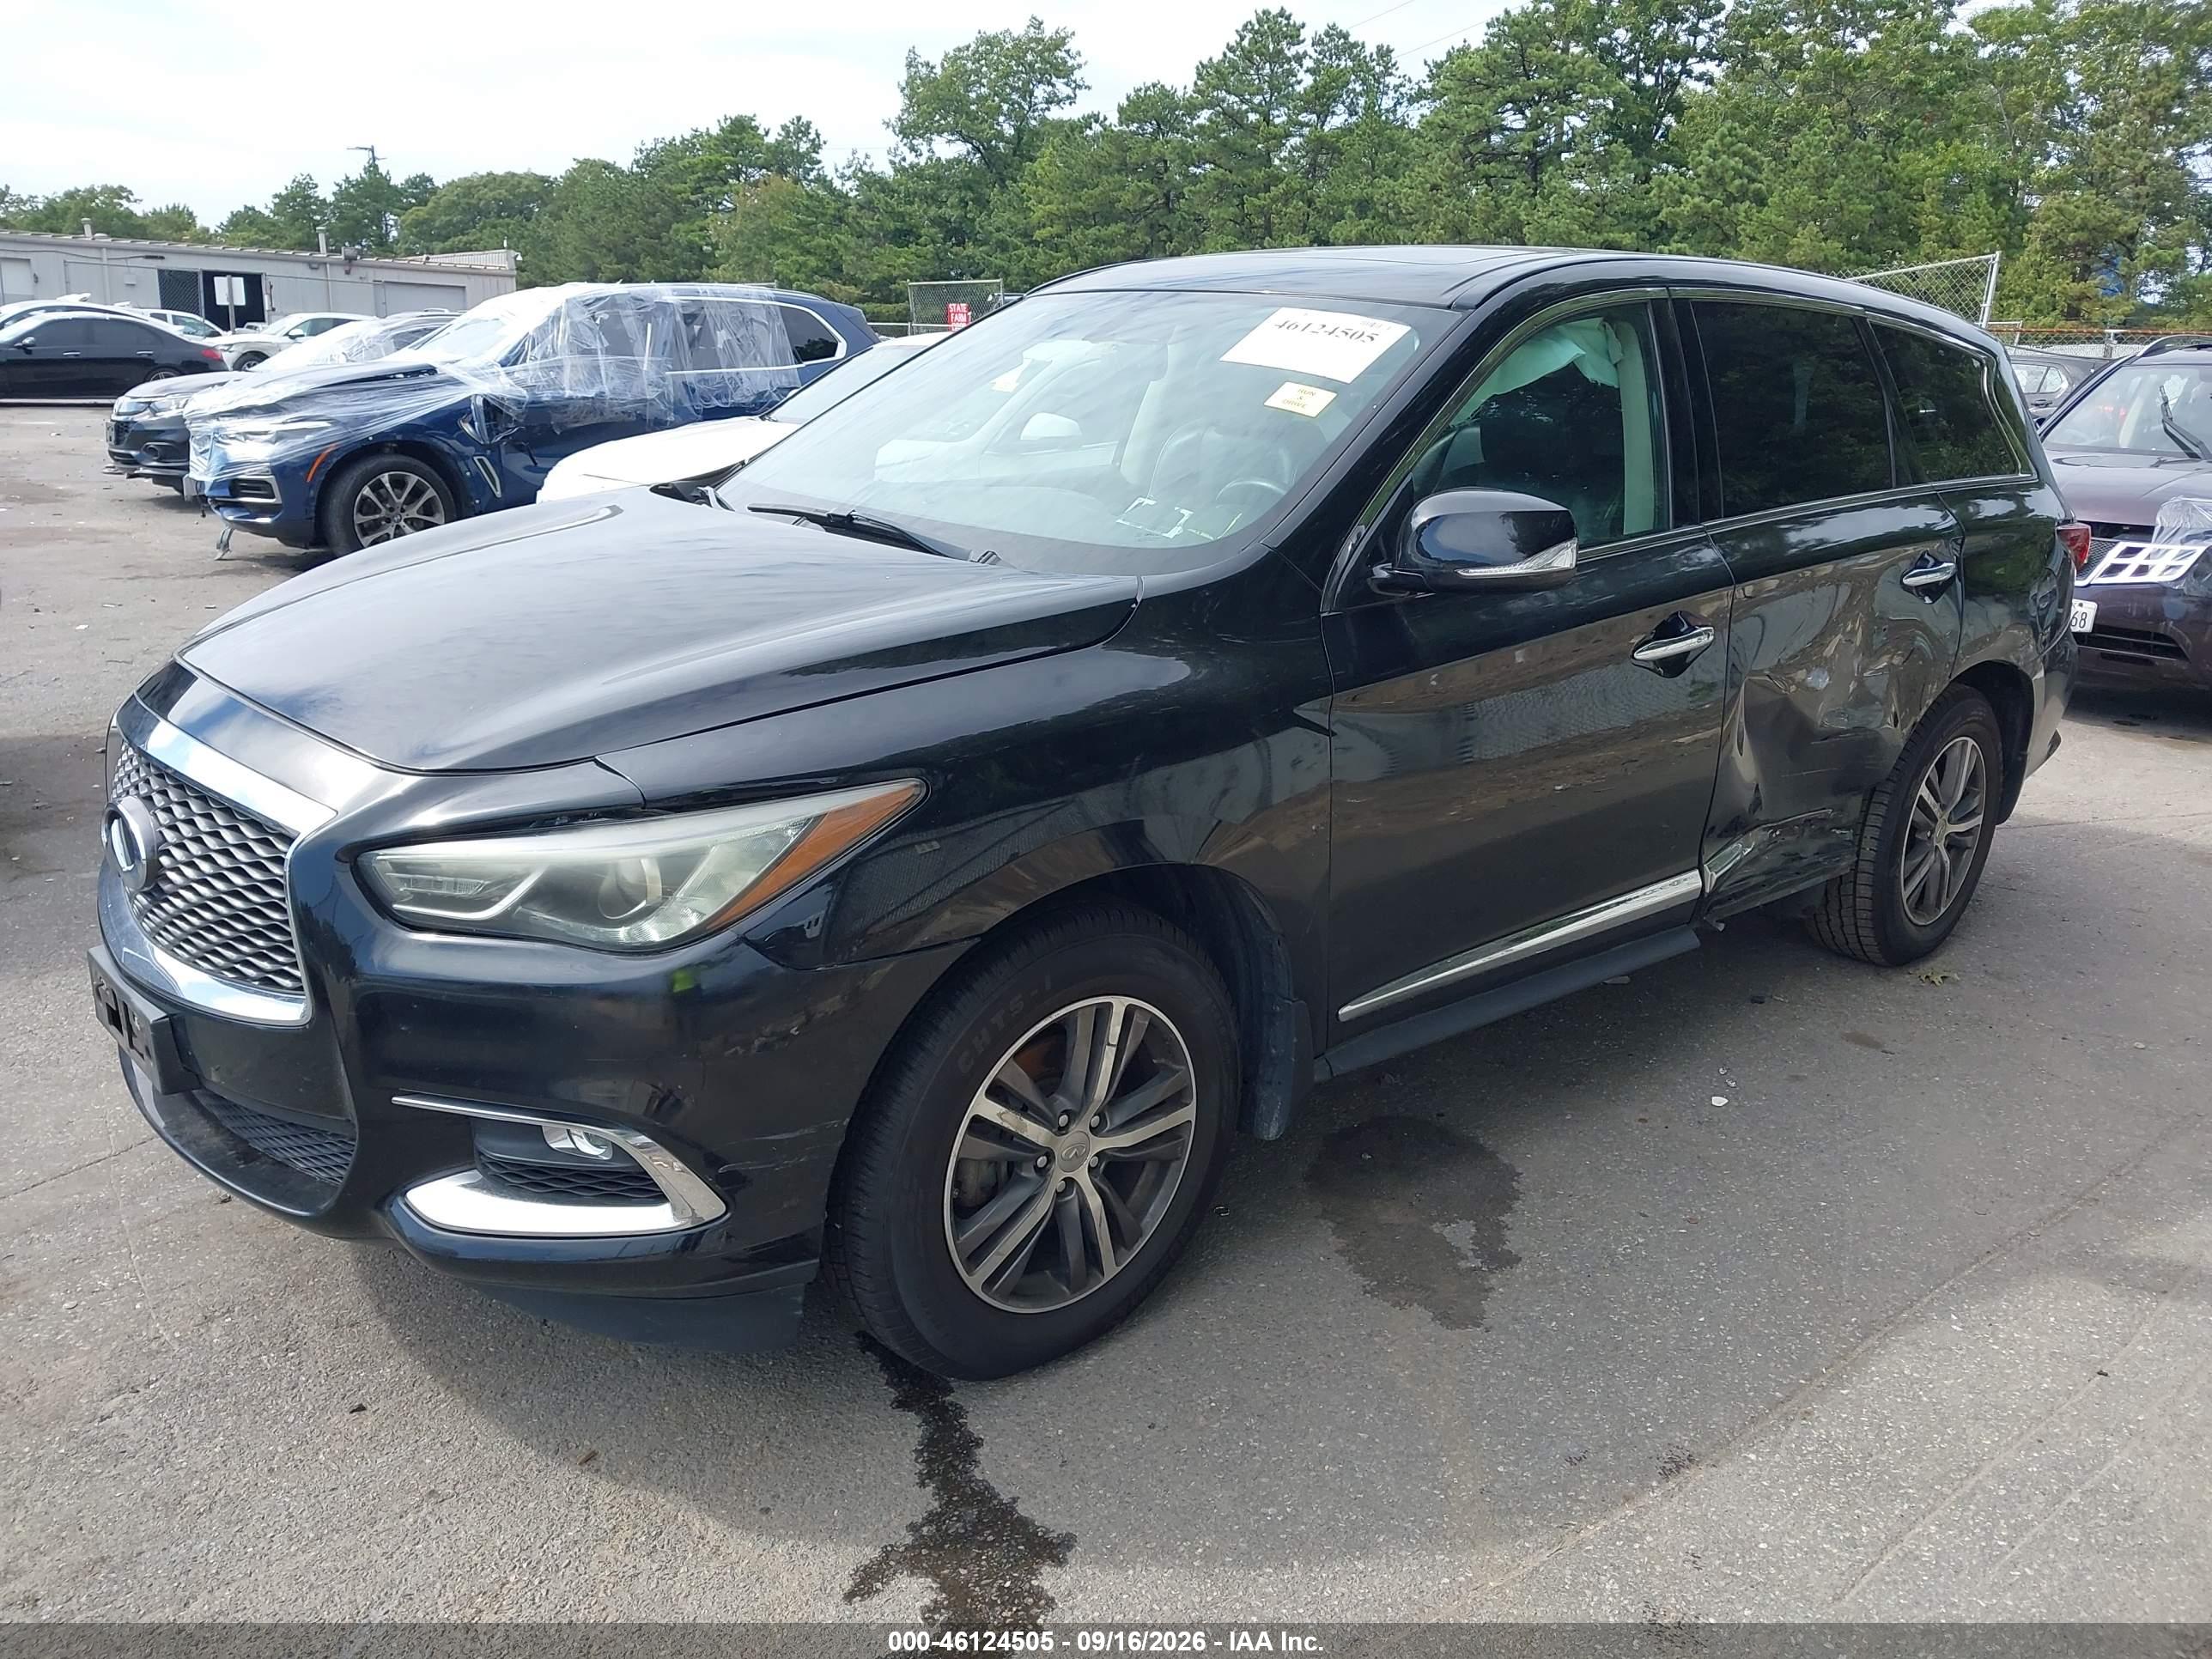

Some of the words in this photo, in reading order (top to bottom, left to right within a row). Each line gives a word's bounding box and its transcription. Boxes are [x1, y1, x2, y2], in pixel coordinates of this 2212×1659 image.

[949, 303, 969, 313] STATE
[1273, 319, 1380, 343] 46124505
[1297, 388, 1316, 398] RUN
[1281, 398, 1309, 410] DRIVE
[2071, 611, 2087, 629] 68
